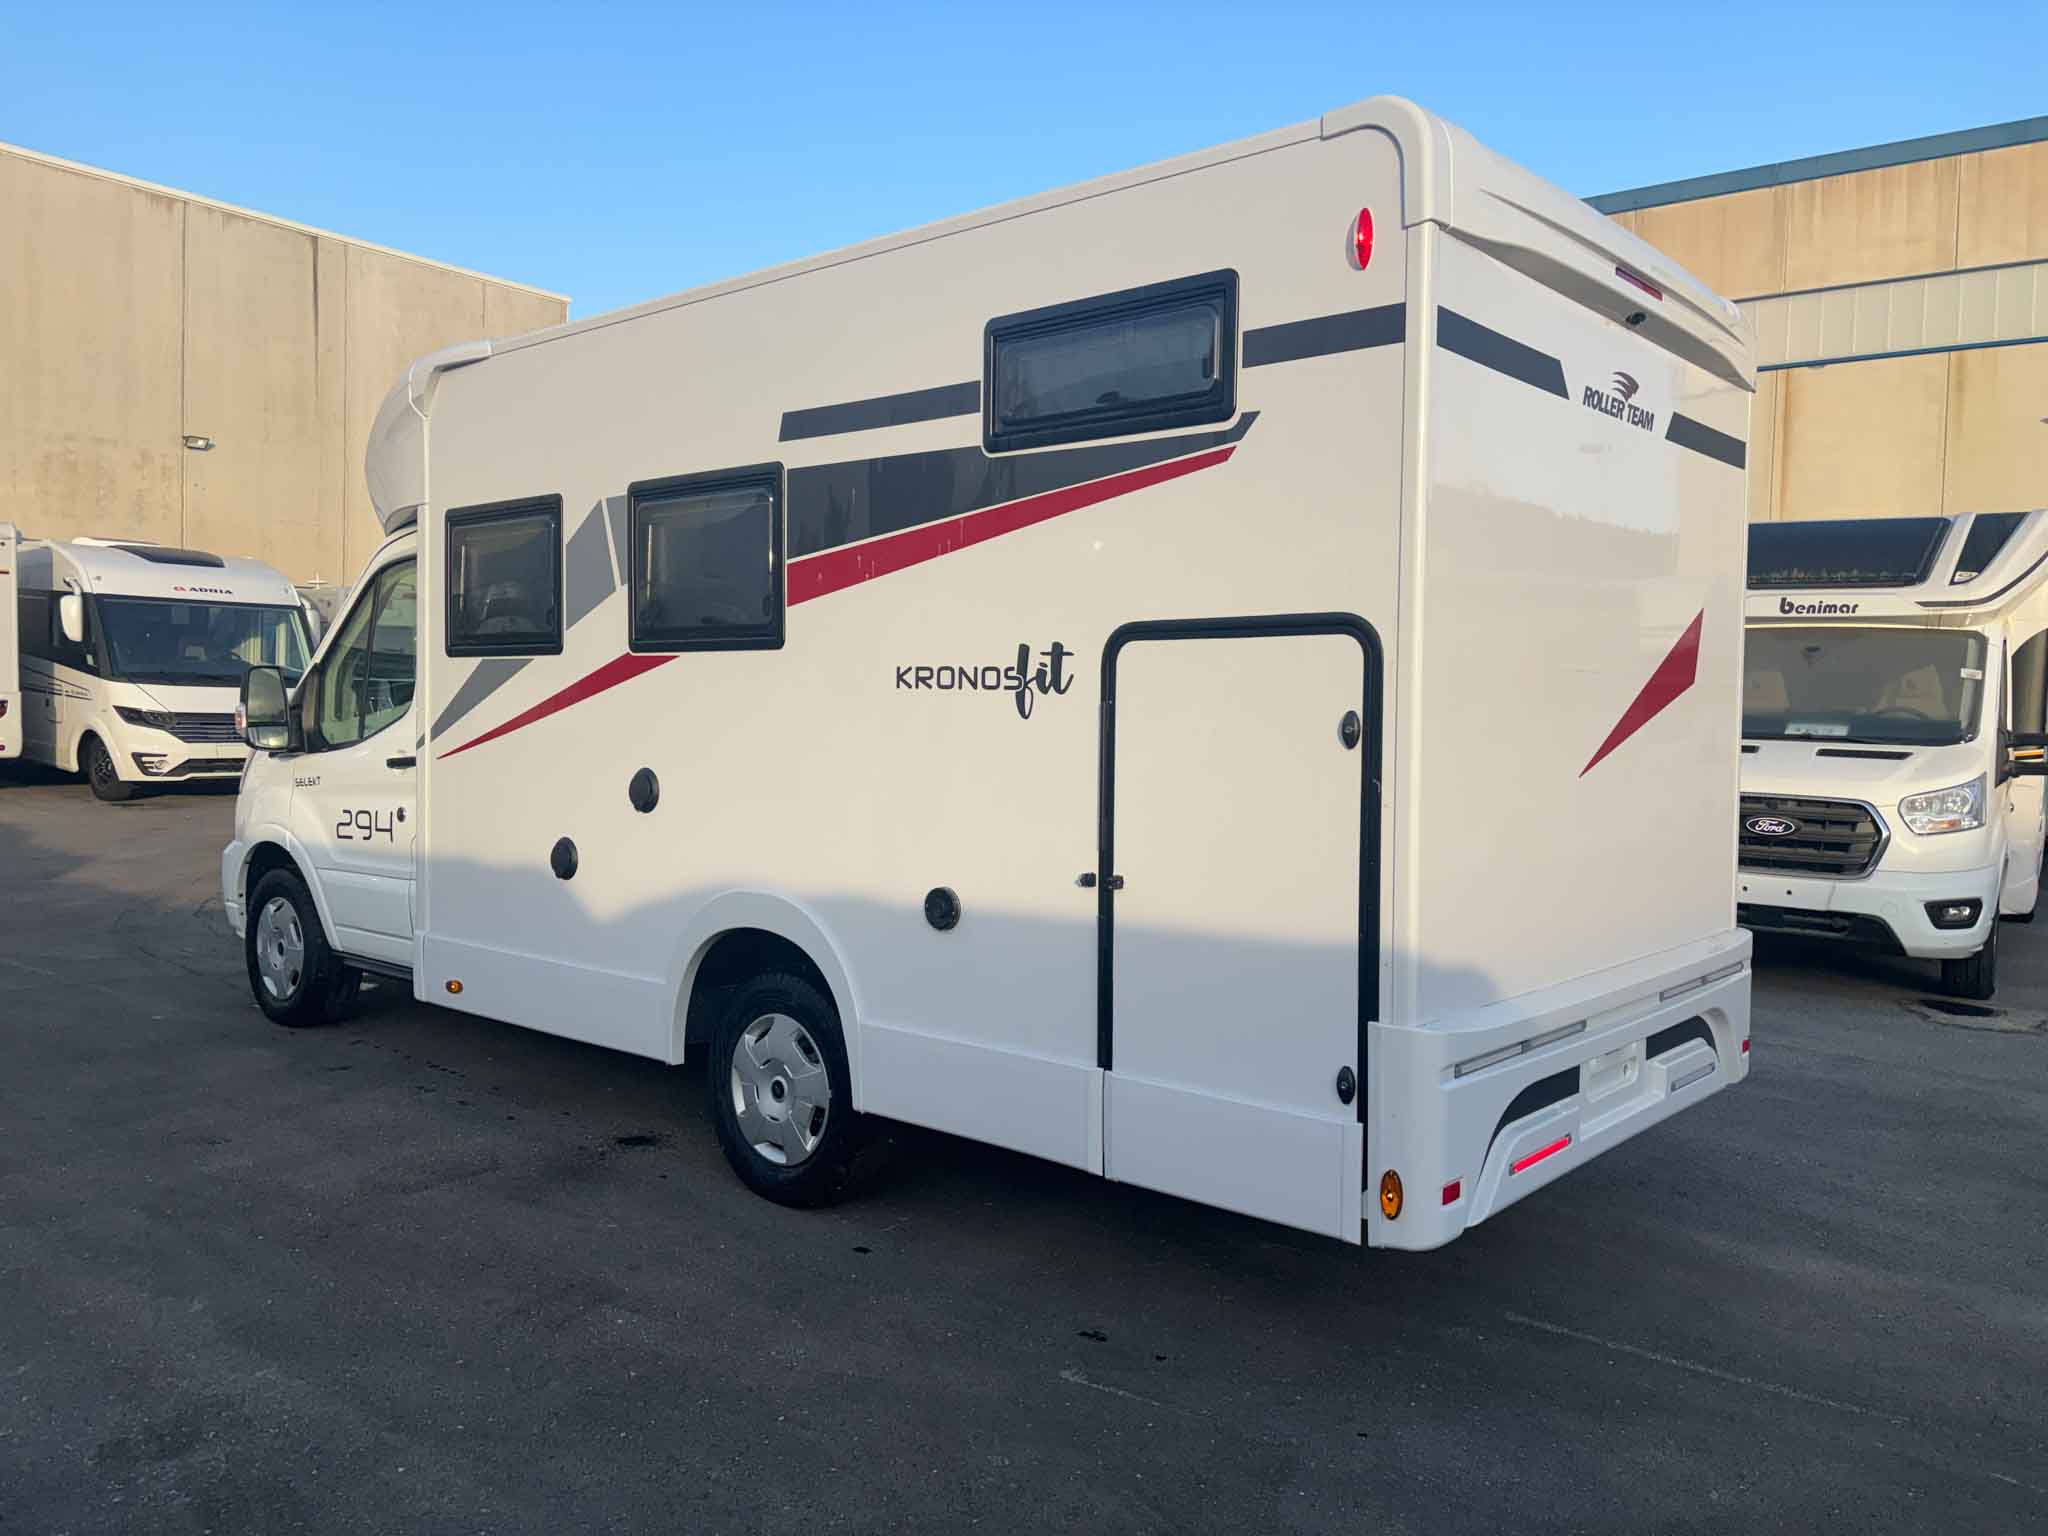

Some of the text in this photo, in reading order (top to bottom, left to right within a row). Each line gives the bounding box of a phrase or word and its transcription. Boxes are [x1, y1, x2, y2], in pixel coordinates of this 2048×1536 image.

[1582, 386, 1655, 432] ROLLER TEAM
[1779, 597, 1859, 615] benimar
[336, 809, 394, 843] 294
[1755, 819, 1786, 832] Ford
